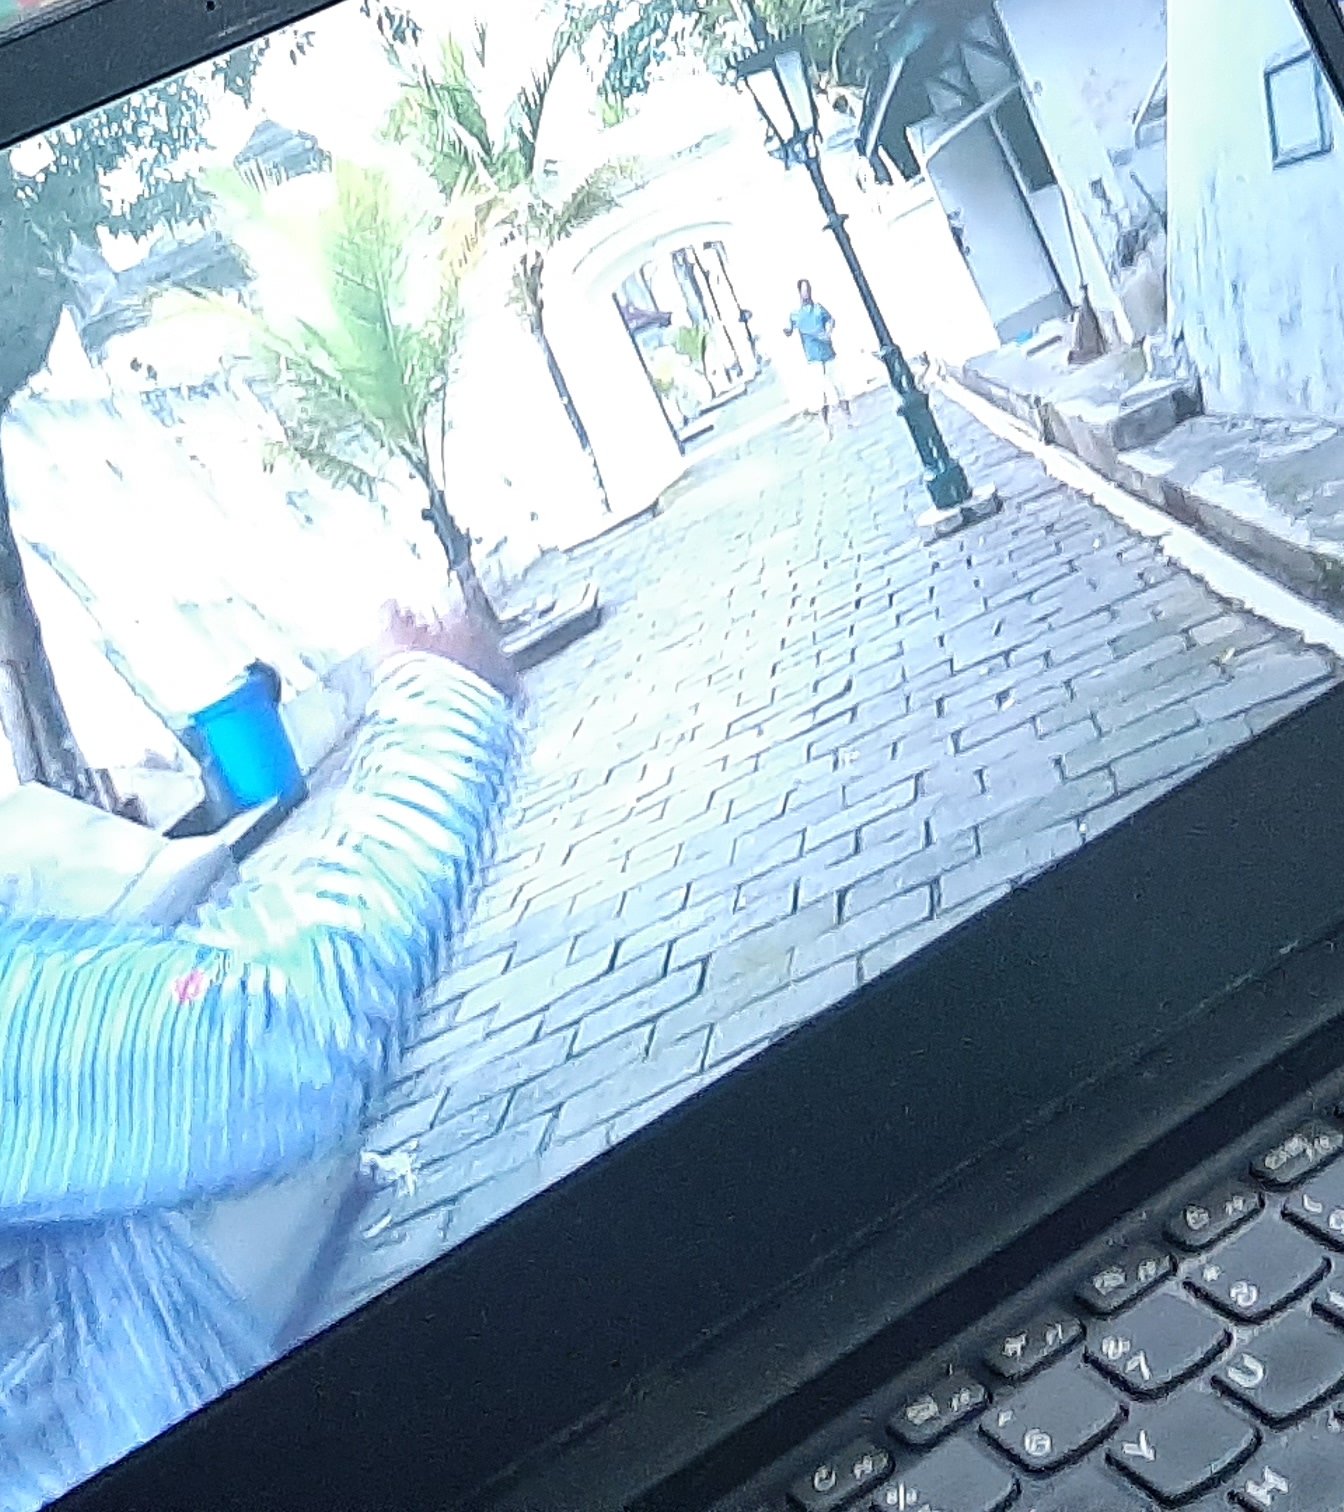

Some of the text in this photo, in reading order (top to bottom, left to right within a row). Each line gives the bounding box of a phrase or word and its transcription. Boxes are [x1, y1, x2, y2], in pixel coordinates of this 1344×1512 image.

[1229, 1280, 1258, 1308] 8
[1124, 1350, 1151, 1381] 7
[1227, 1352, 1265, 1388] U
[1023, 1427, 1053, 1457] 6
[1121, 1429, 1156, 1462] Y
[1245, 1465, 1290, 1507] H
